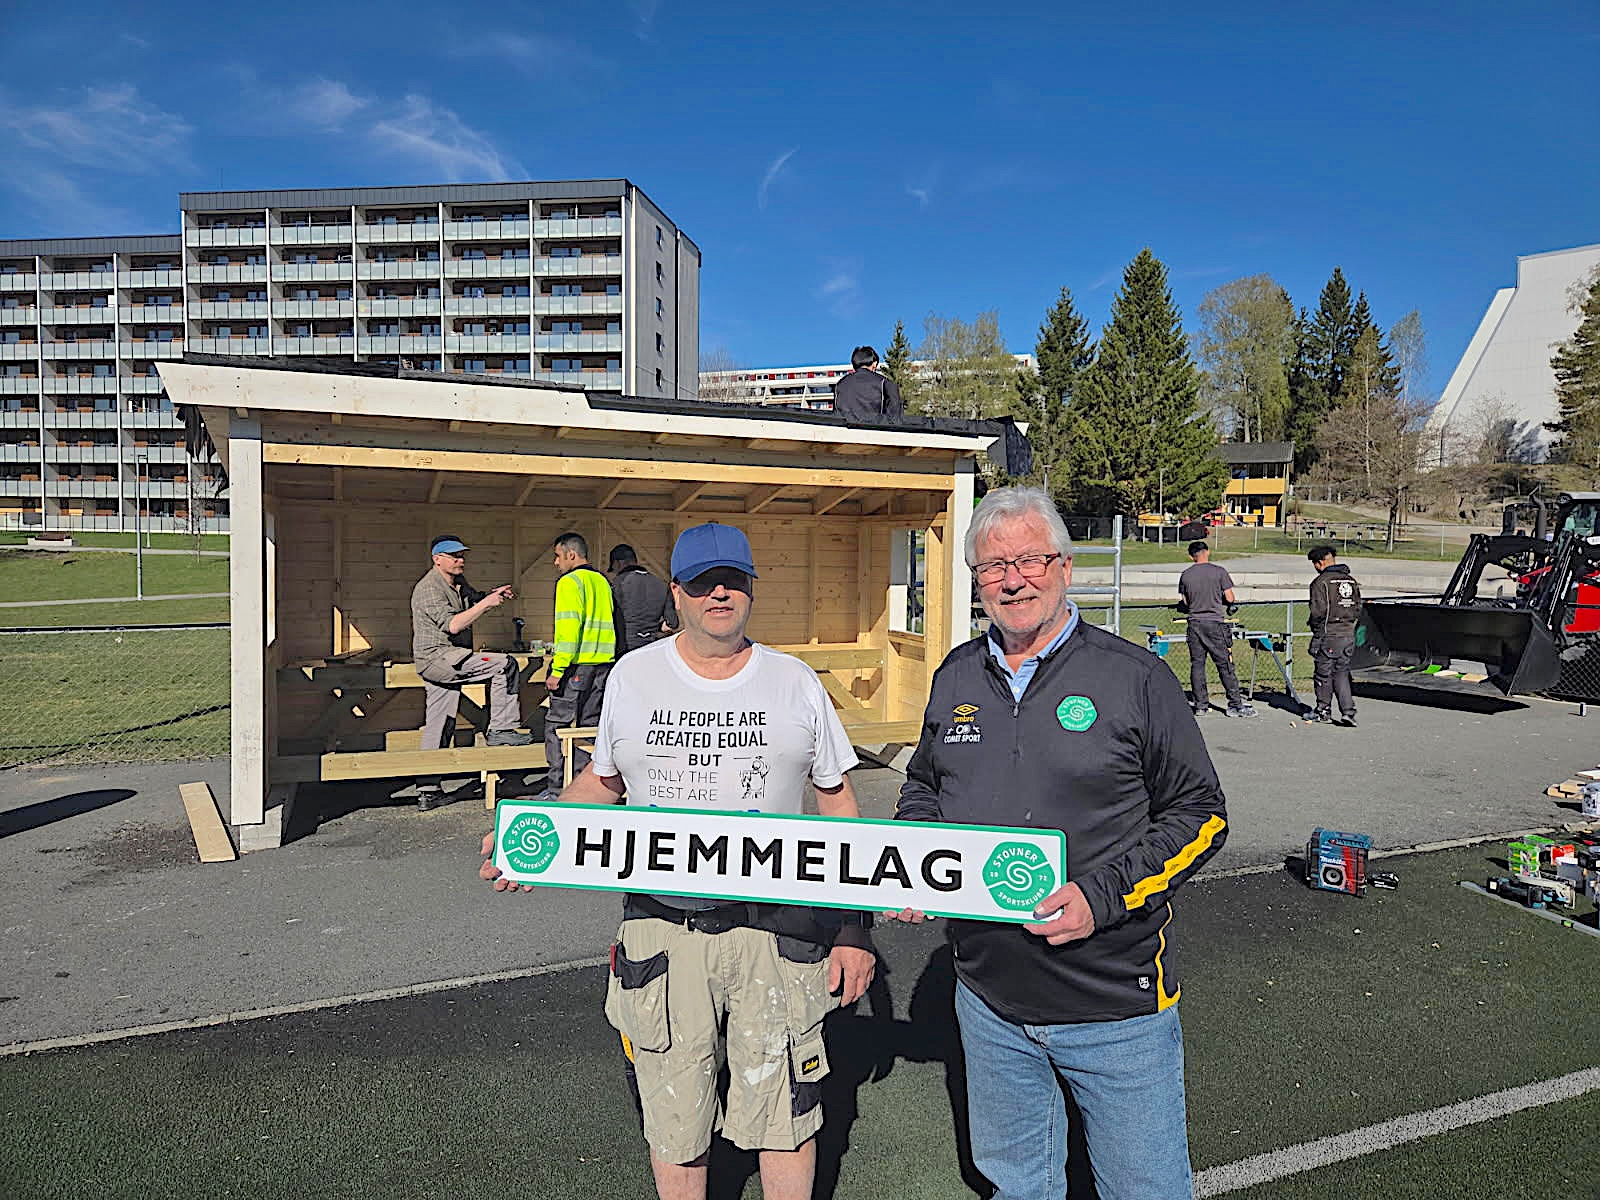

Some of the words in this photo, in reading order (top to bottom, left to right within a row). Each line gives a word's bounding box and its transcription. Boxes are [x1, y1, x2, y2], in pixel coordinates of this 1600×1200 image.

[649, 709, 674, 726] ALL
[678, 711, 735, 727] PEOPLE
[738, 711, 767, 726] ARE
[646, 730, 711, 748] CREATED
[718, 730, 768, 748] EQUAL
[962, 734, 981, 743] SPORT
[688, 753, 722, 766] BUT
[647, 768, 685, 783] ONLY
[689, 770, 718, 784] THE
[649, 784, 683, 799] BEST
[687, 788, 719, 801] ARE
[511, 817, 548, 836] STOVNER
[574, 827, 963, 892] HJEMMELAG
[992, 847, 1038, 867] STOVNER
